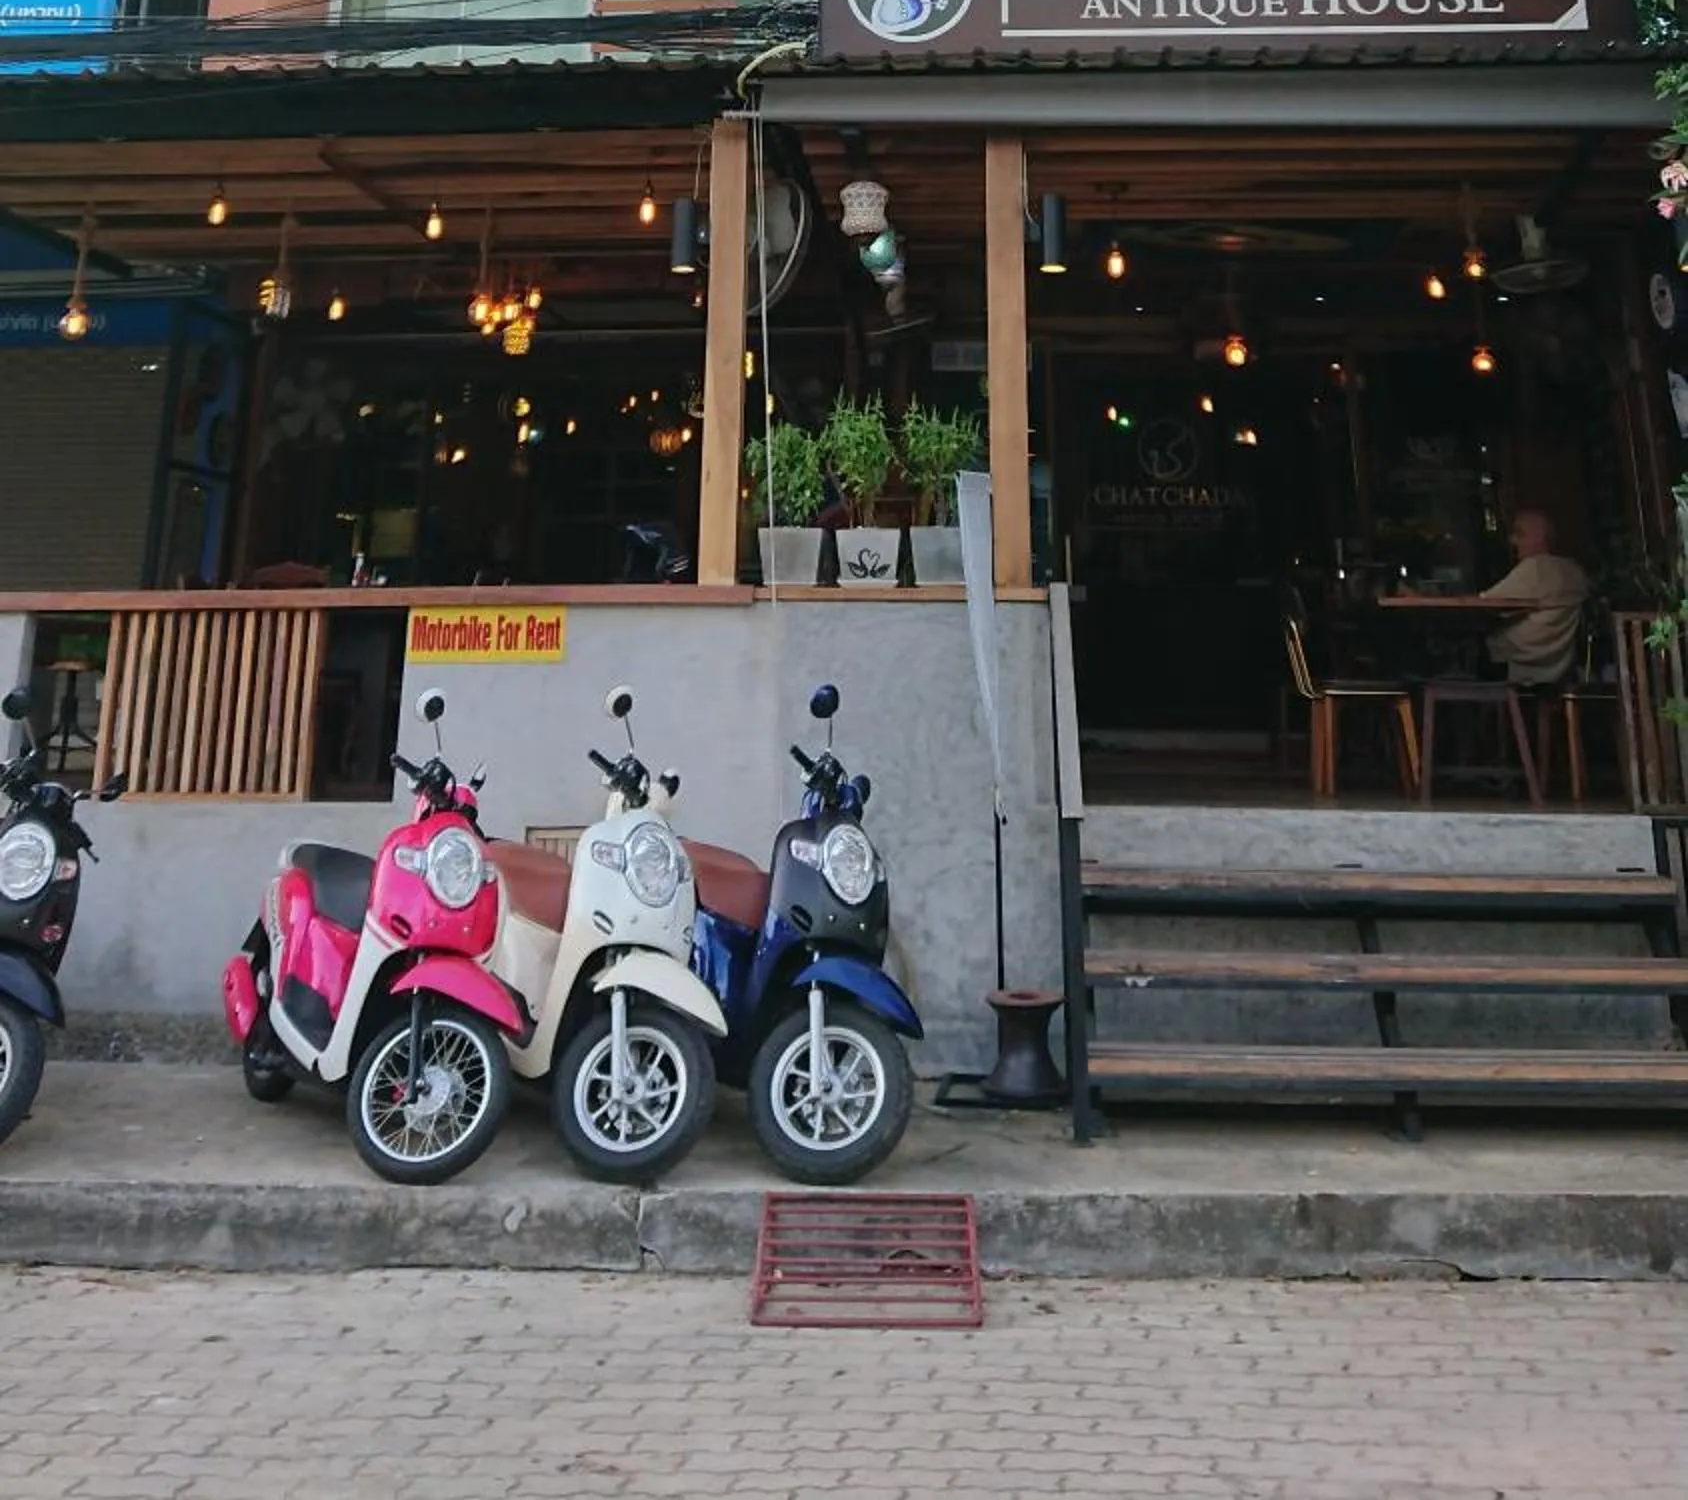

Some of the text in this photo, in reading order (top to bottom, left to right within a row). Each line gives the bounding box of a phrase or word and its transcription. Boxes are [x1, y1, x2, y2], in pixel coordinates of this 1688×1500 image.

[411, 614, 561, 652] Motorbike For Rent
